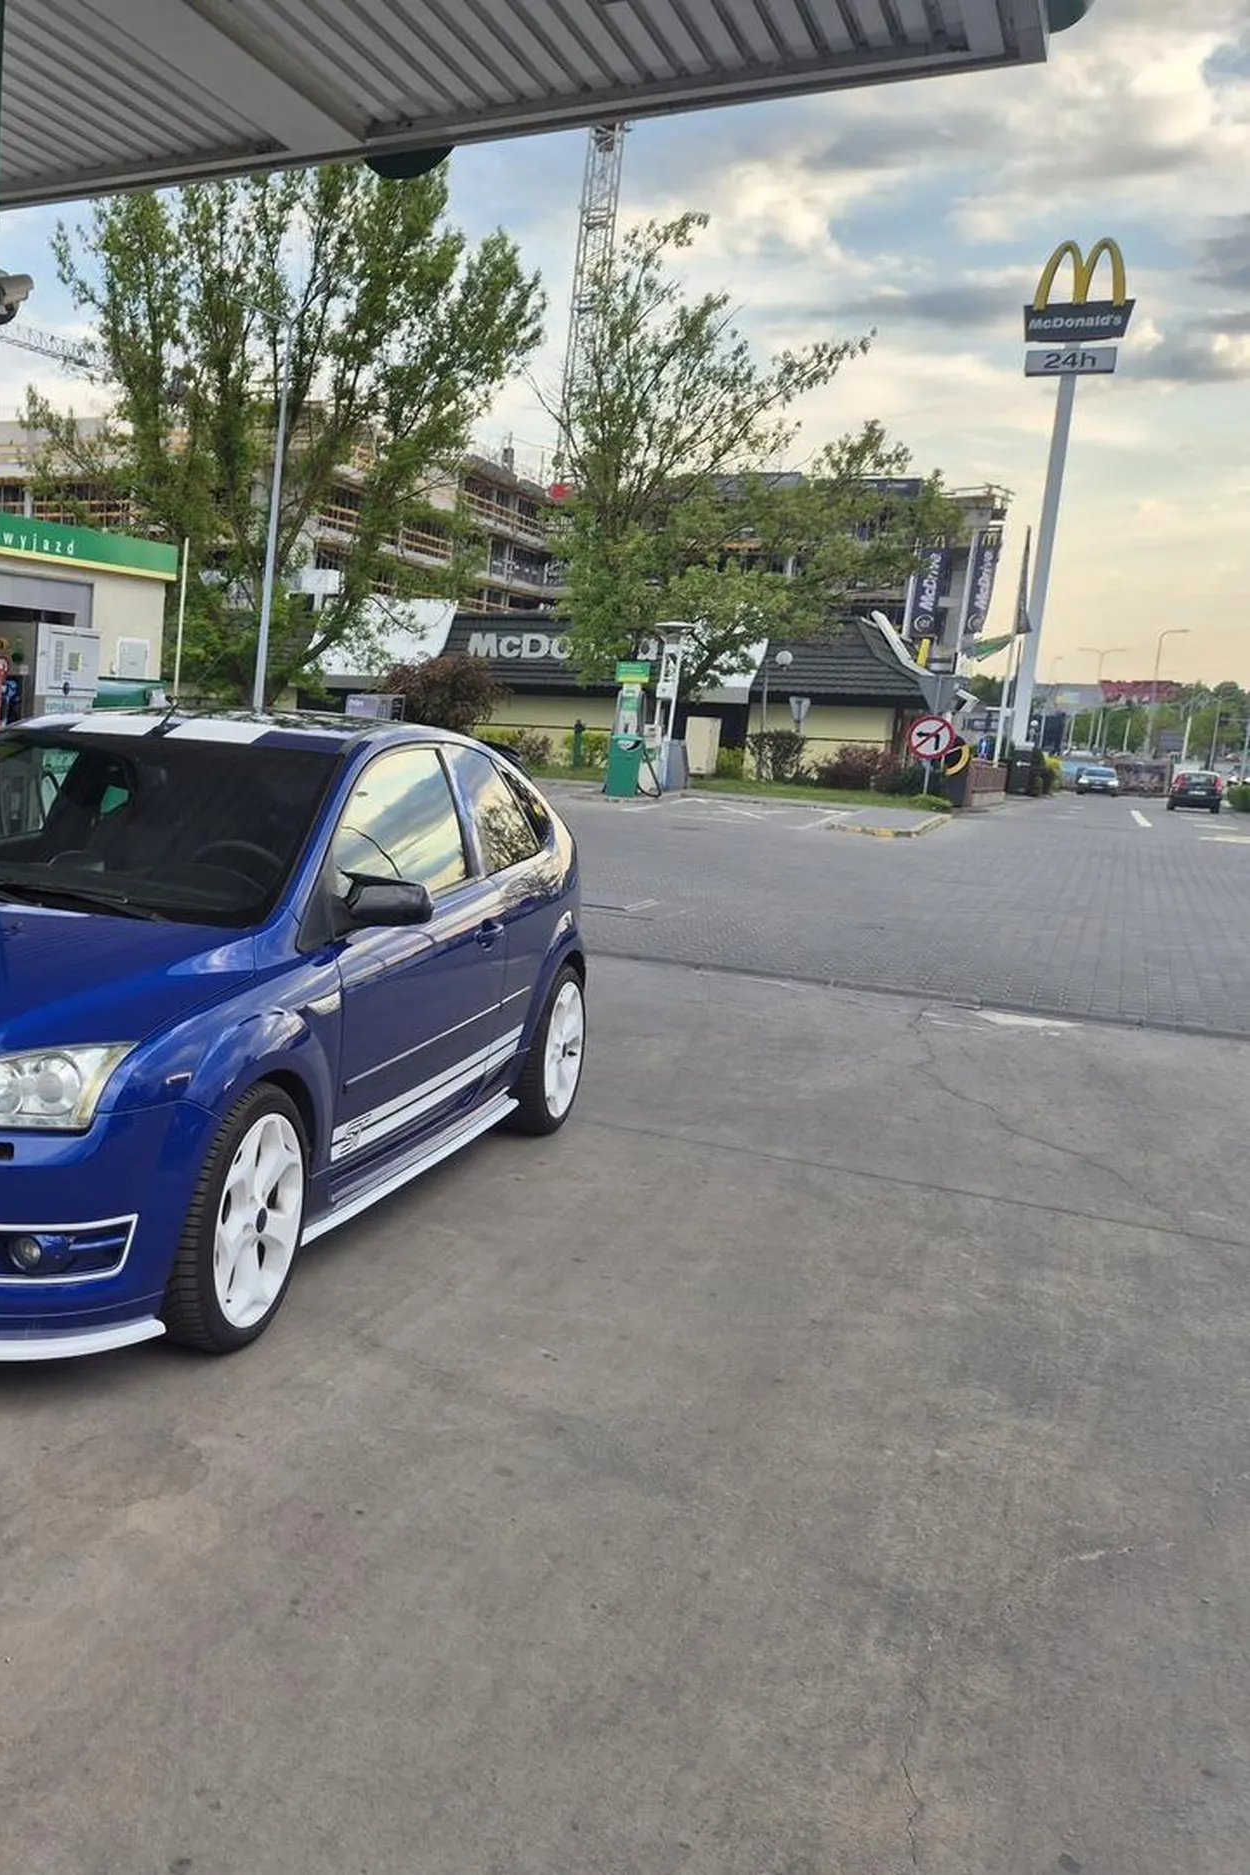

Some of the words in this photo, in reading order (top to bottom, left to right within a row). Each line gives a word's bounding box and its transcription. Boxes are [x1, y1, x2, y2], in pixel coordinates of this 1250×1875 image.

[1028, 315, 1123, 331] McDonald's
[1043, 352, 1097, 369] 24h
[2, 531, 75, 555] wyjazd
